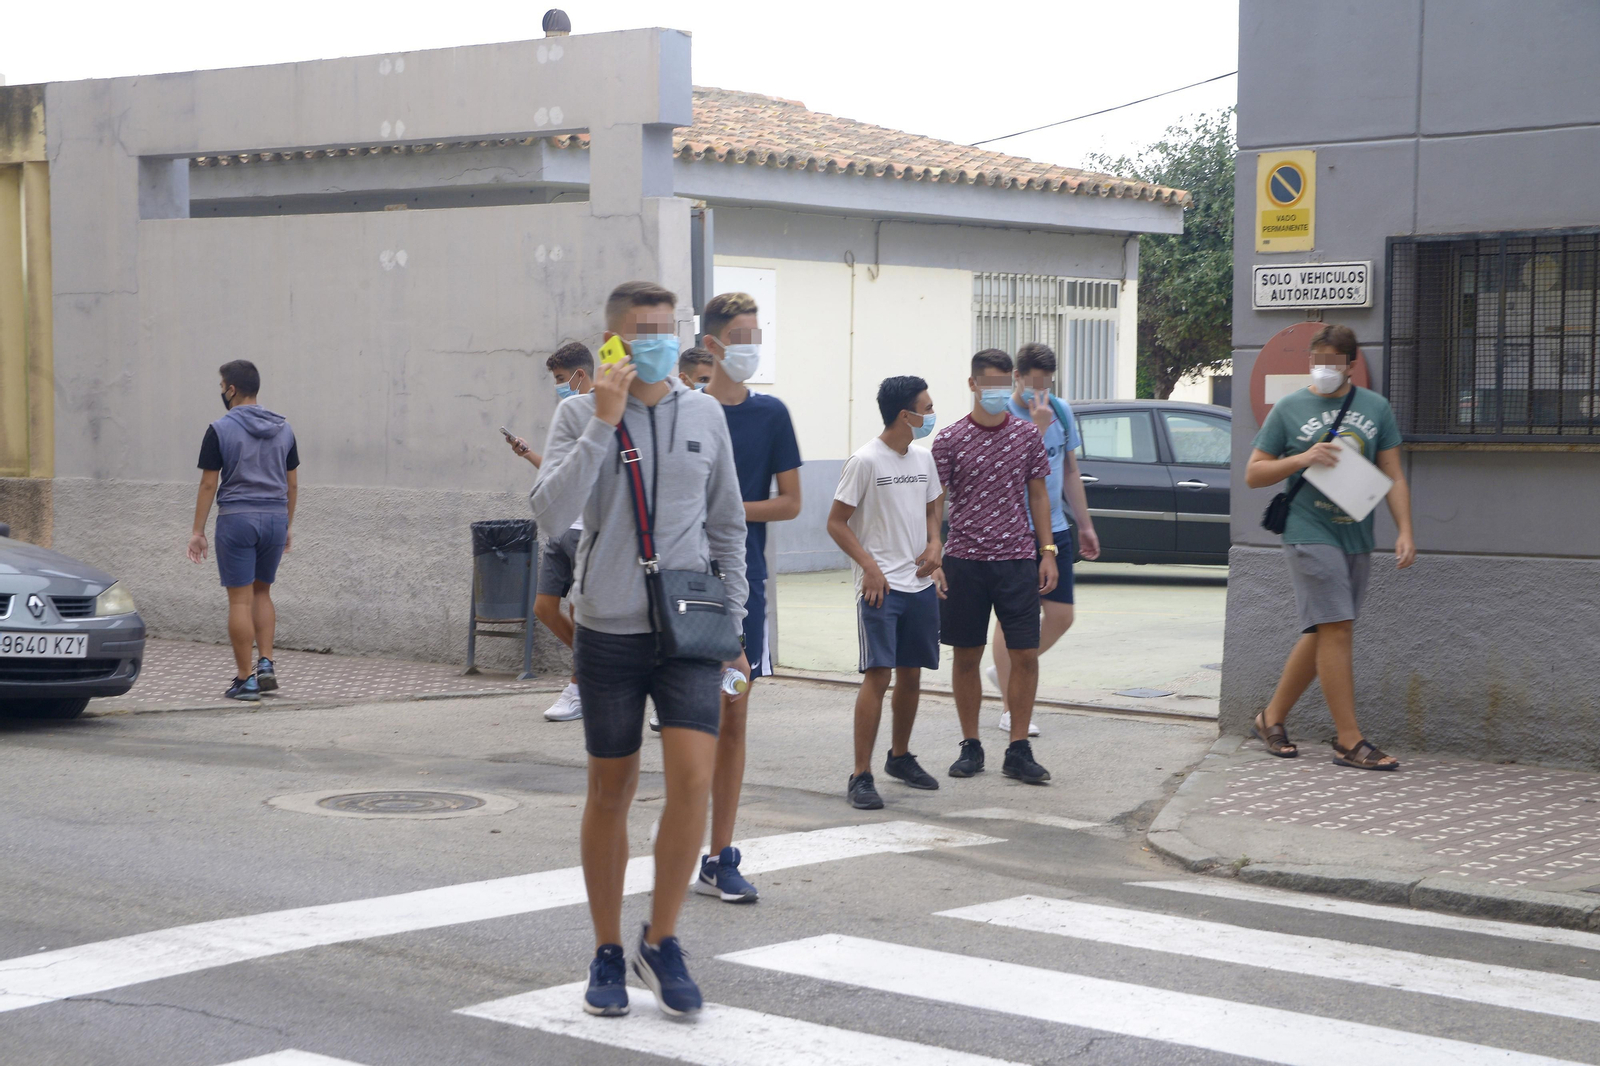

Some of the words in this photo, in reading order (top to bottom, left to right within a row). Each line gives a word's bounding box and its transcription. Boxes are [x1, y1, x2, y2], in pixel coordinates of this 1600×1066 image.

[1276, 214, 1297, 222] VADO
[1262, 224, 1309, 233] PERMANENTE
[1261, 273, 1292, 286] SOLO
[1300, 271, 1365, 284] VEHICULOS
[1271, 287, 1354, 301] AUTORIZADOS
[1296, 417, 1324, 442] LOS
[893, 474, 919, 485] adidas
[1, 635, 48, 654] 9640
[53, 636, 86, 655] KZY
